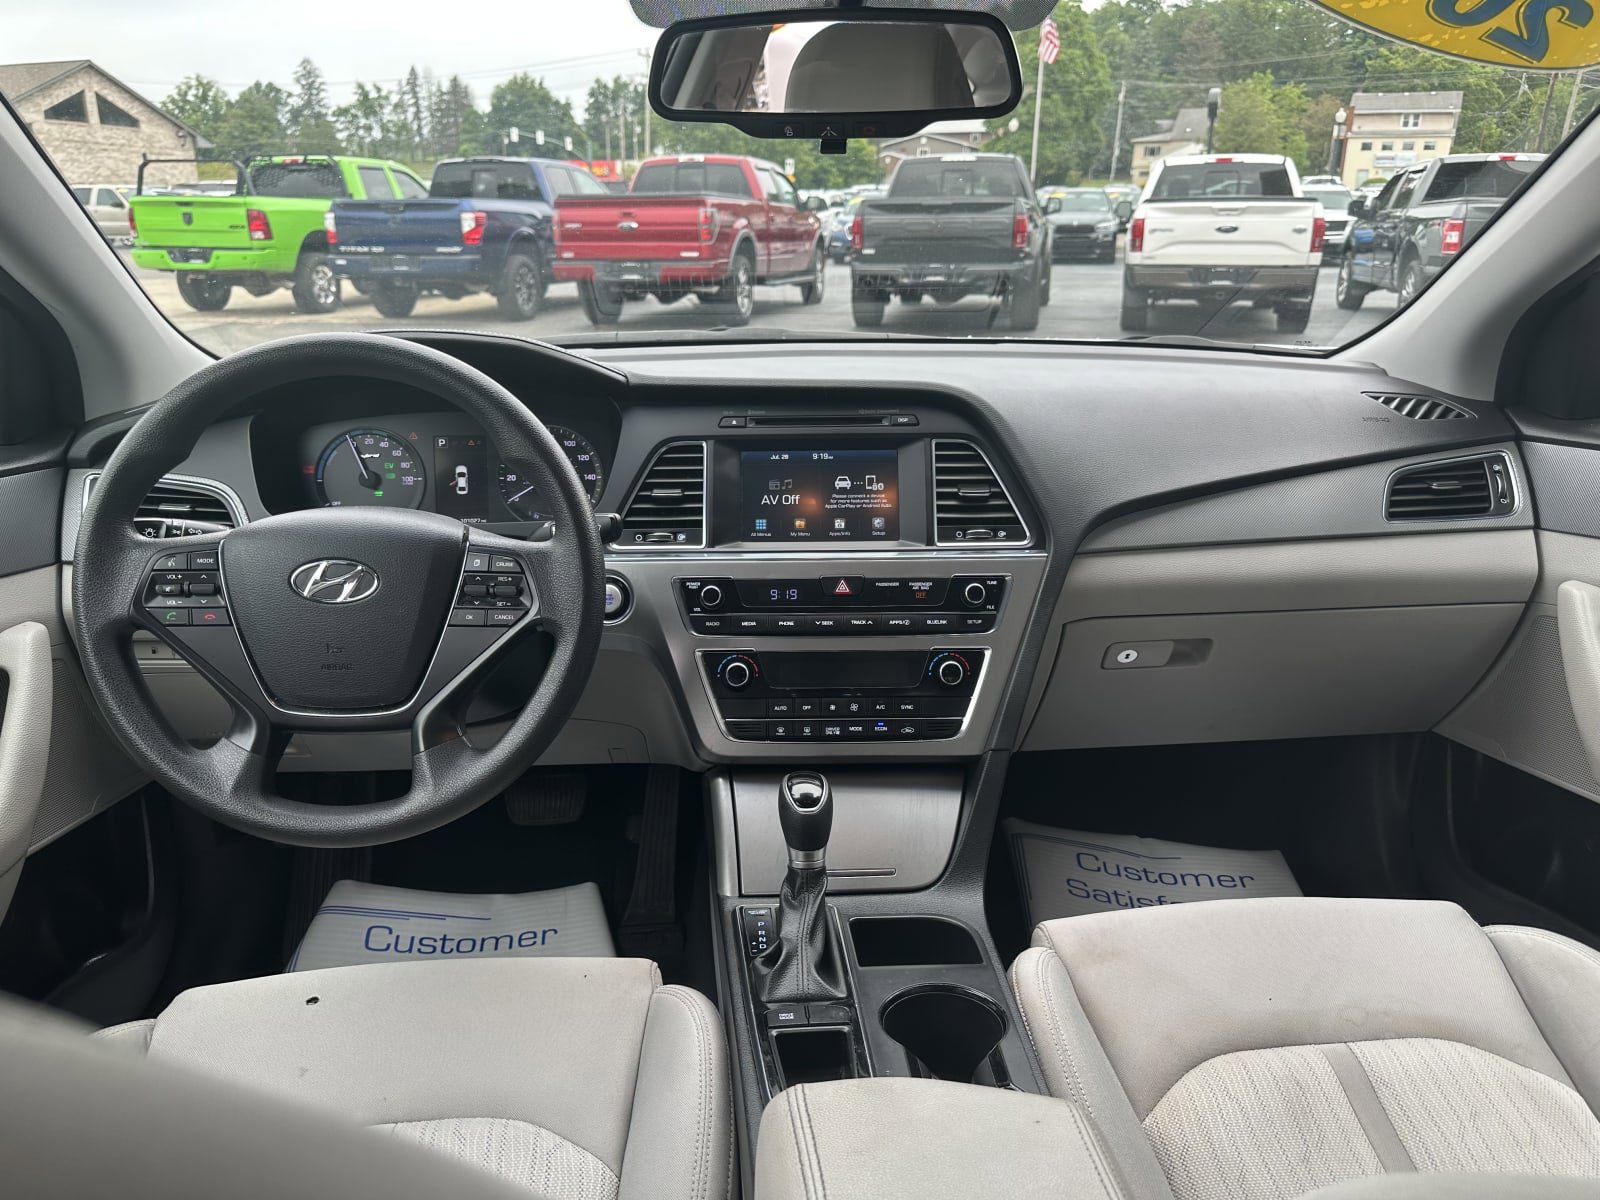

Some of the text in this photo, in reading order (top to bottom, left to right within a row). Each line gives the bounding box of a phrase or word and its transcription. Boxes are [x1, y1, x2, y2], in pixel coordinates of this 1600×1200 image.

[438, 439, 446, 447] P
[400, 461, 410, 469] 80
[583, 473, 596, 481] 140
[761, 494, 801, 505] AV Off
[770, 589, 798, 600] 9:19
[1075, 852, 1255, 889] Customer
[363, 924, 558, 955] Customer
